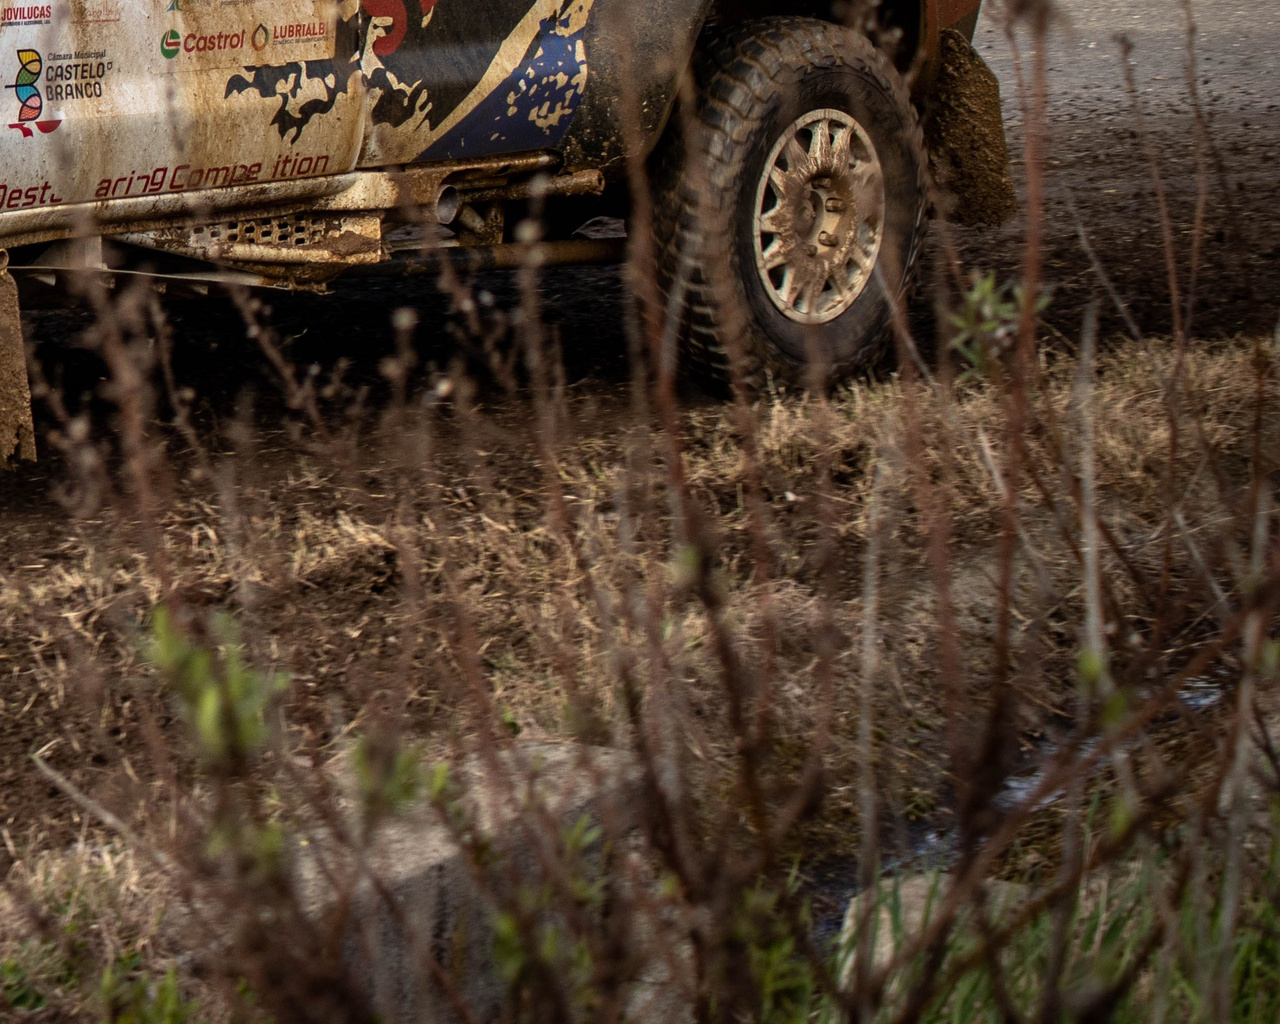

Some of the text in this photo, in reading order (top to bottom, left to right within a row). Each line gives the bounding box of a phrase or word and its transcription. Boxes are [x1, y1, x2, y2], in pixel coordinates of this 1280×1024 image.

[1, 5, 52, 22] JOVILUCAS
[184, 28, 246, 53] Castrol
[47, 50, 106, 61] Câmara Municipal
[46, 62, 105, 82] CASTELO
[46, 82, 102, 101] BRANCO
[169, 152, 330, 190] Compeition
